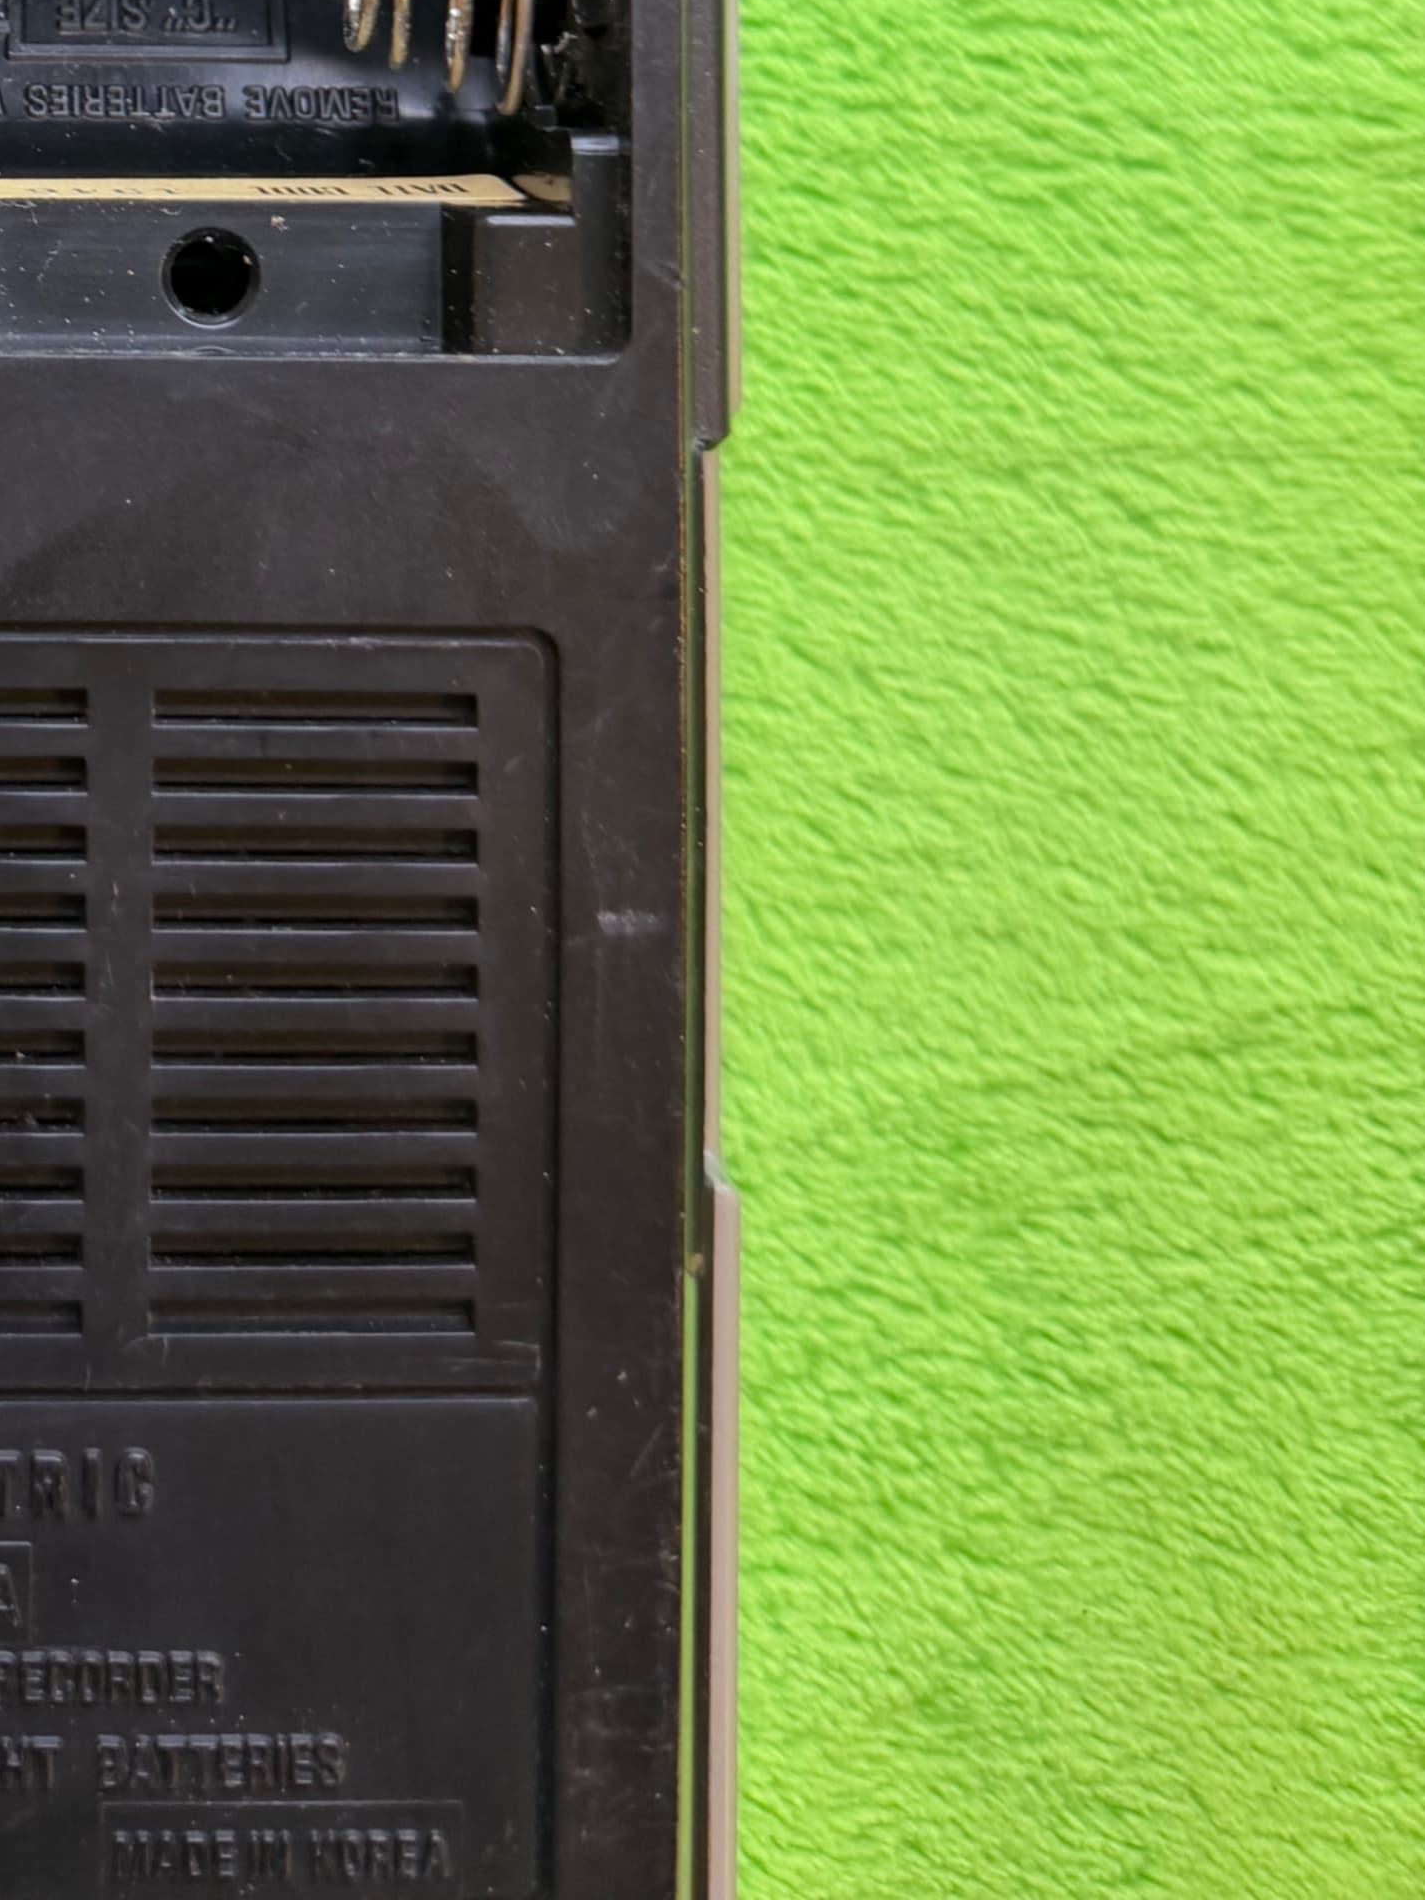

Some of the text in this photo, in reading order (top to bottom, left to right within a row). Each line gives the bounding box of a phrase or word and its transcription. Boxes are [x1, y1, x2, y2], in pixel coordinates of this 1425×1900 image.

[24, 82, 225, 120] BATTERIES
[244, 84, 397, 121] REMOVE
[94, 1732, 351, 1792] BATTERIES
[111, 1826, 454, 1883] MADE IN KOREA
